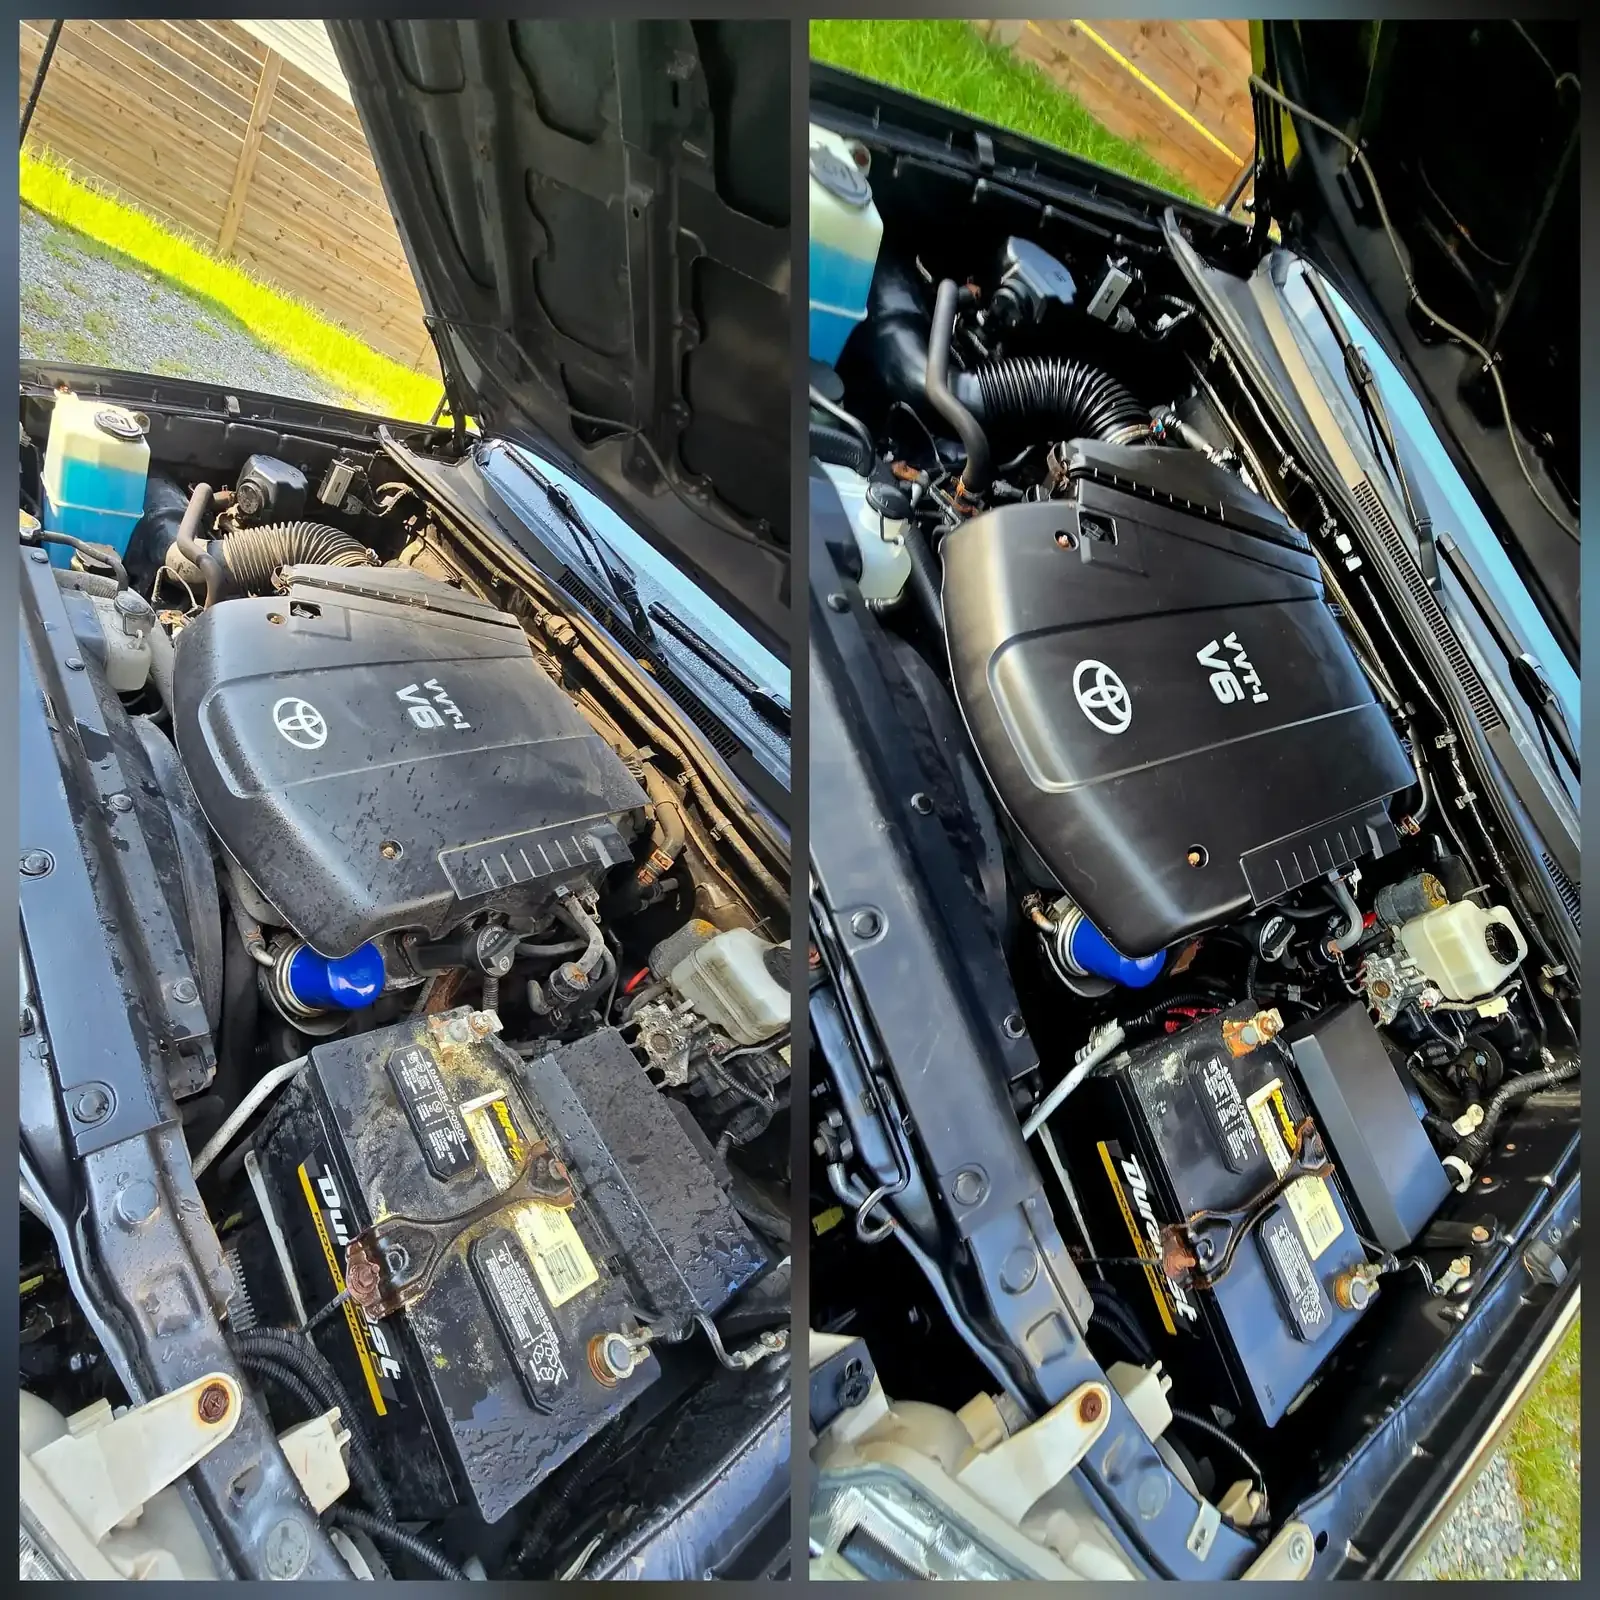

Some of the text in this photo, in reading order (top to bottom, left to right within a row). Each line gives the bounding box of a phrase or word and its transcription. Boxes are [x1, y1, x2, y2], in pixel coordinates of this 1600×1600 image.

[395, 683, 446, 729] V6
[1196, 639, 1246, 704] V6
[429, 1067, 449, 1102] DANGER
[447, 1108, 467, 1142] POISON
[314, 1211, 366, 1355] PROVEN OUGH
[354, 1301, 384, 1378] OLD
